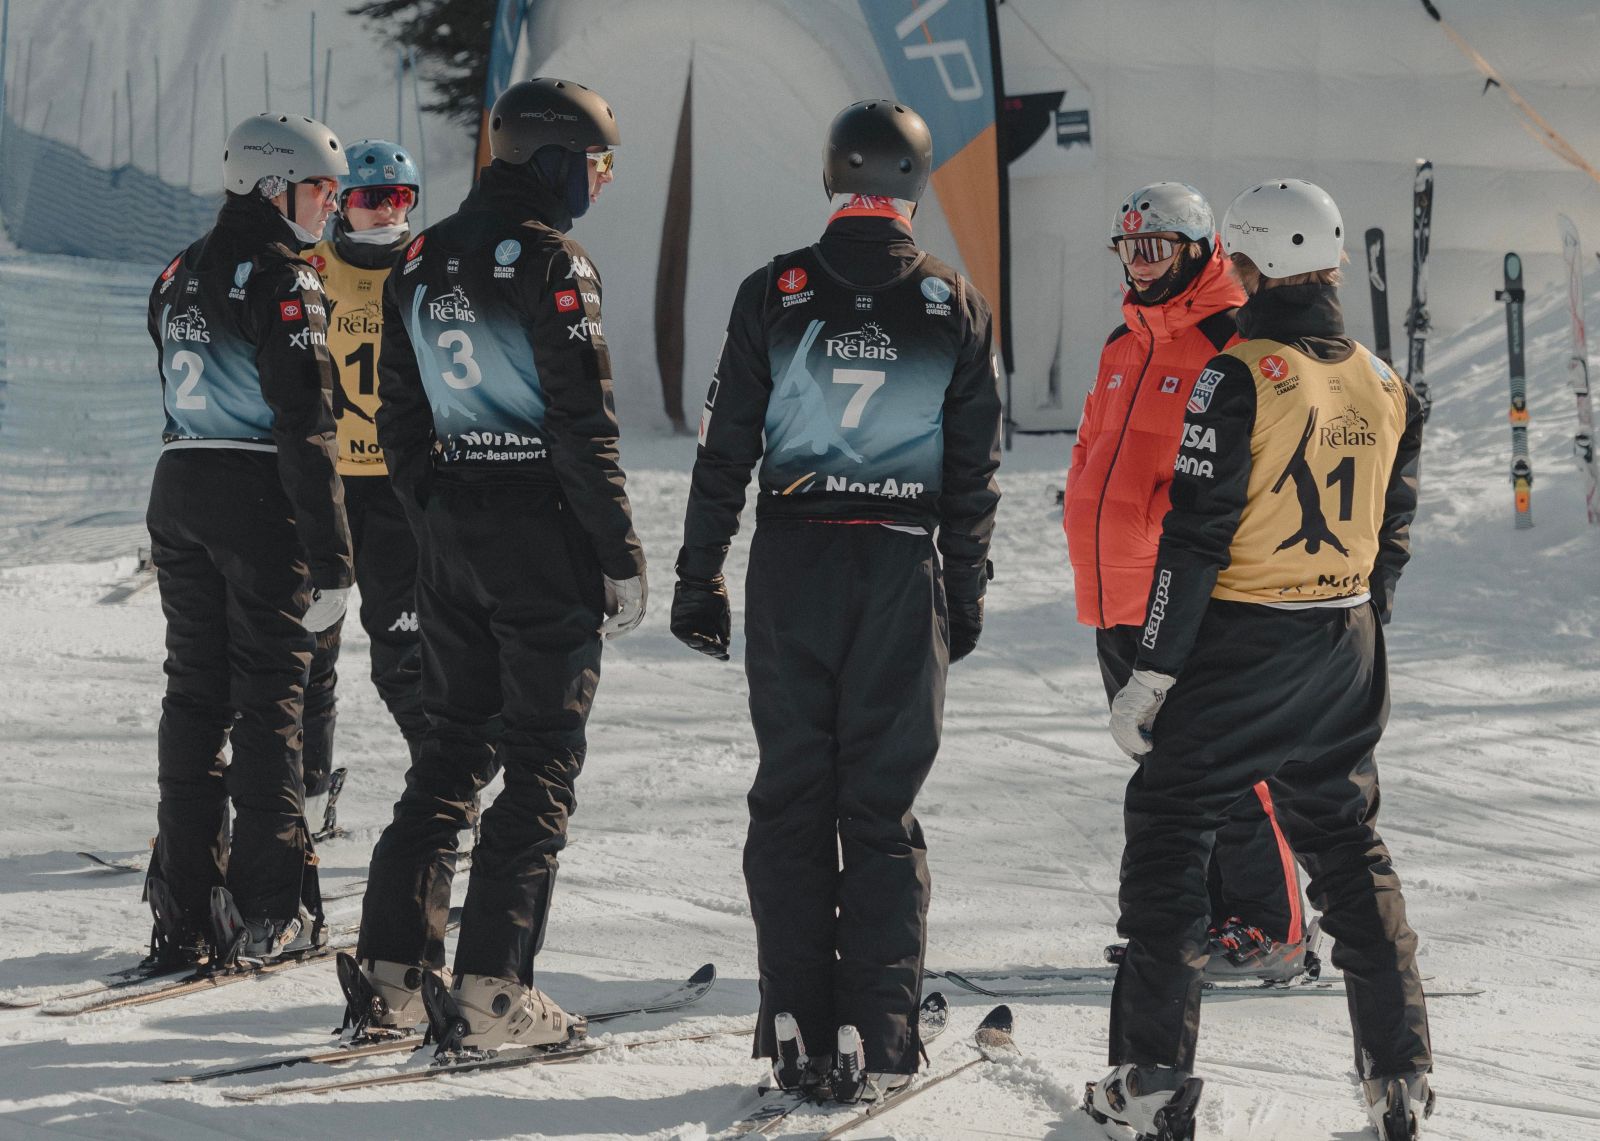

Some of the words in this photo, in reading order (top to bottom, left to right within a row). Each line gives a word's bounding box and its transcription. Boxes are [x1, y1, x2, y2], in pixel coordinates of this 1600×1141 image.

[428, 302, 476, 323] Relais
[167, 322, 211, 344] Relais
[844, 336, 857, 345] Le
[437, 329, 482, 390] 3
[825, 339, 898, 361] Relais
[171, 350, 207, 410] 2
[345, 342, 375, 395] 1
[1201, 368, 1221, 386] US
[831, 368, 886, 429] 7
[1320, 426, 1377, 450] Relais
[825, 475, 924, 496] NorAm
[1326, 456, 1356, 522] 1
[1141, 569, 1172, 650] Kappa
